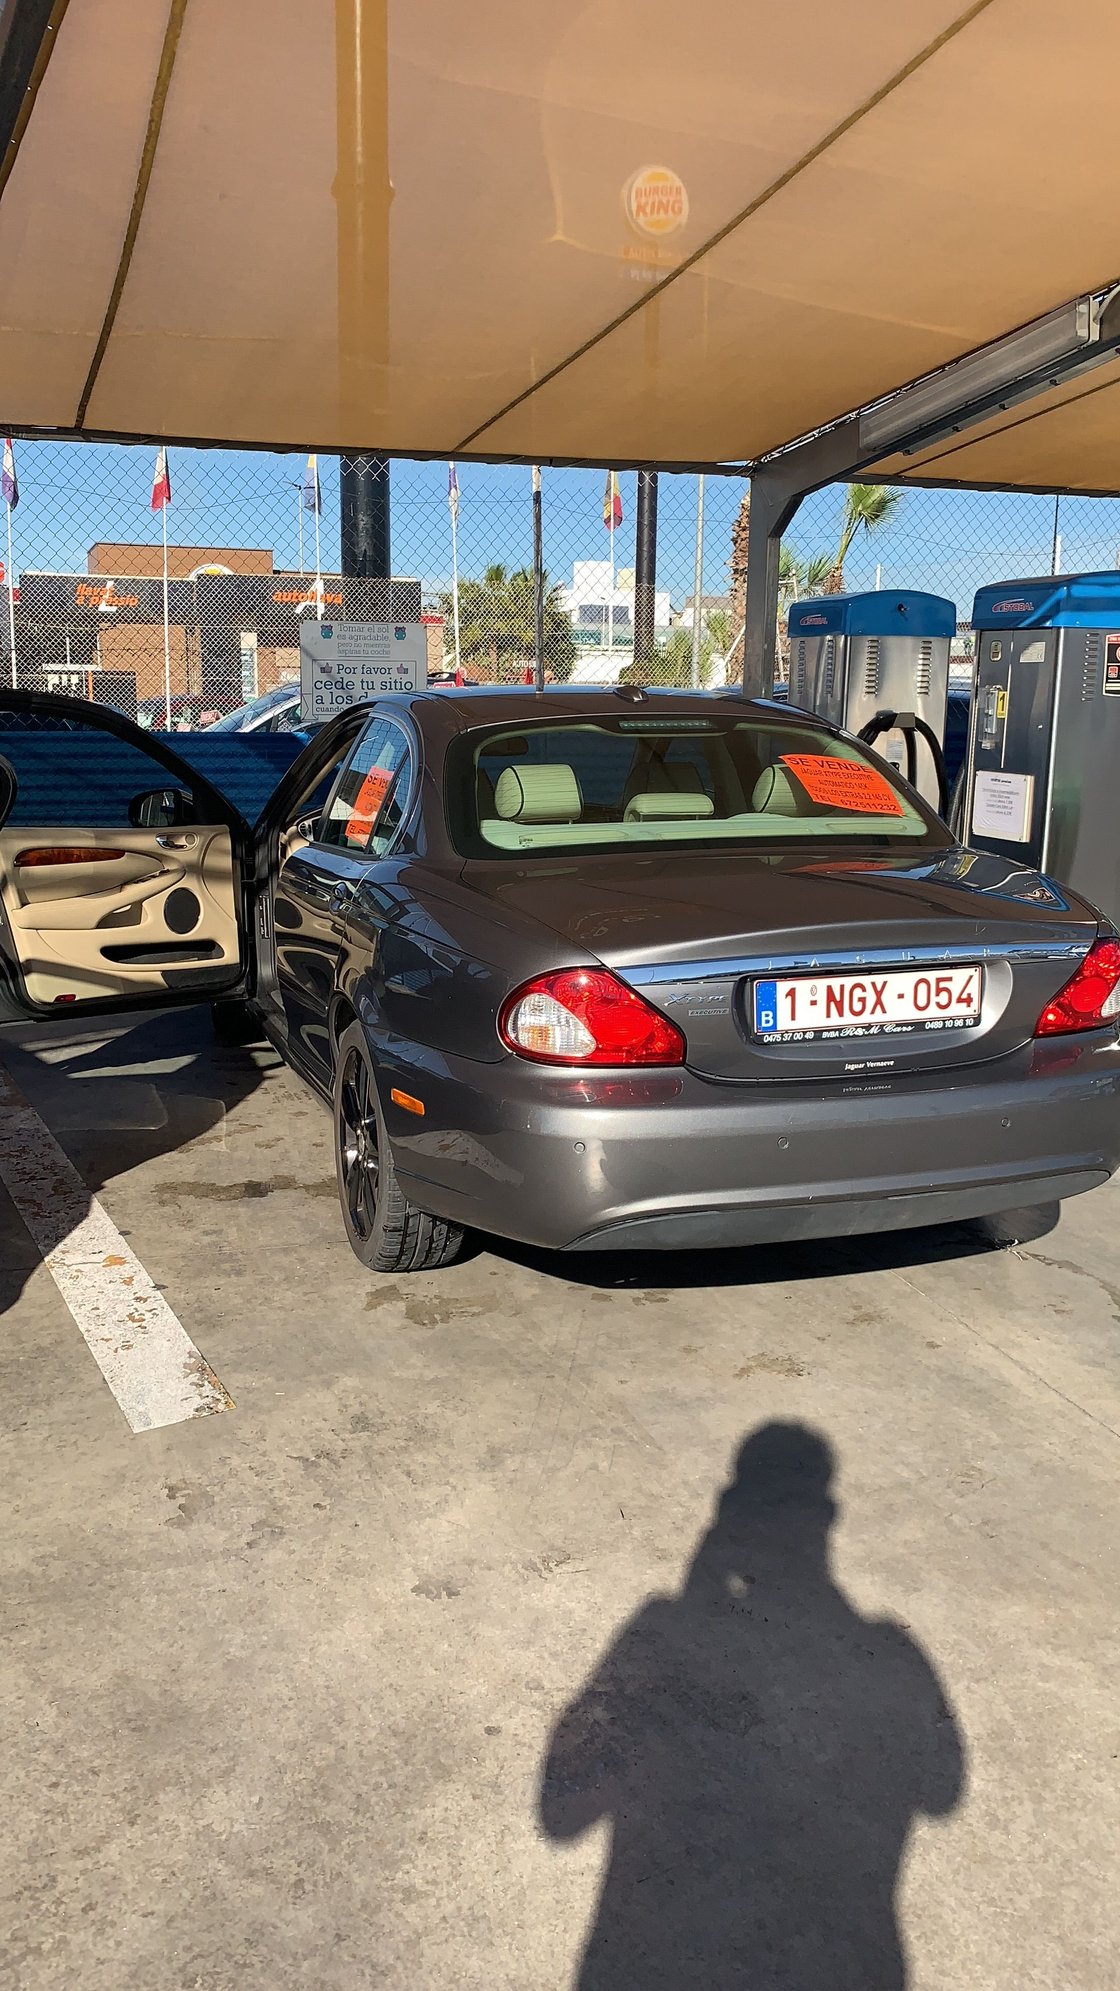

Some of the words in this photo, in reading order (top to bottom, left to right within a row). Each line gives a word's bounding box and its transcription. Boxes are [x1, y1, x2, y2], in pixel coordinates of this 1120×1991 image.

[635, 184, 682, 199] BURGER
[635, 200, 683, 218] KING
[338, 624, 365, 633] Tomar
[367, 624, 375, 633] el
[377, 624, 390, 634] sol
[348, 633, 391, 642] agradable,
[337, 664, 358, 675] Por
[361, 664, 393, 675] favor
[314, 677, 356, 691] cede
[360, 678, 376, 691] tu
[380, 677, 414, 691] sitio
[315, 695, 324, 705] a
[329, 692, 353, 705] los
[786, 757, 811, 768] SE
[813, 760, 873, 773] VENDE
[785, 974, 974, 1022] 1-NGX-054
[690, 1008, 728, 1016] EXECUTIVE
[761, 1011, 774, 1028] B
[763, 1033, 782, 1043] 0475
[783, 1032, 792, 1041] 37
[793, 1031, 803, 1040] 00
[804, 1031, 815, 1039] 49
[822, 1030, 839, 1039] BVBA
[883, 1023, 916, 1034] Cars
[925, 1020, 944, 1030] 0489
[944, 1019, 954, 1028] 10
[954, 1018, 964, 1027] 96
[965, 1017, 974, 1026] 10
[844, 1062, 866, 1071] Jaguar
[866, 1060, 895, 1068] Vernaeve
